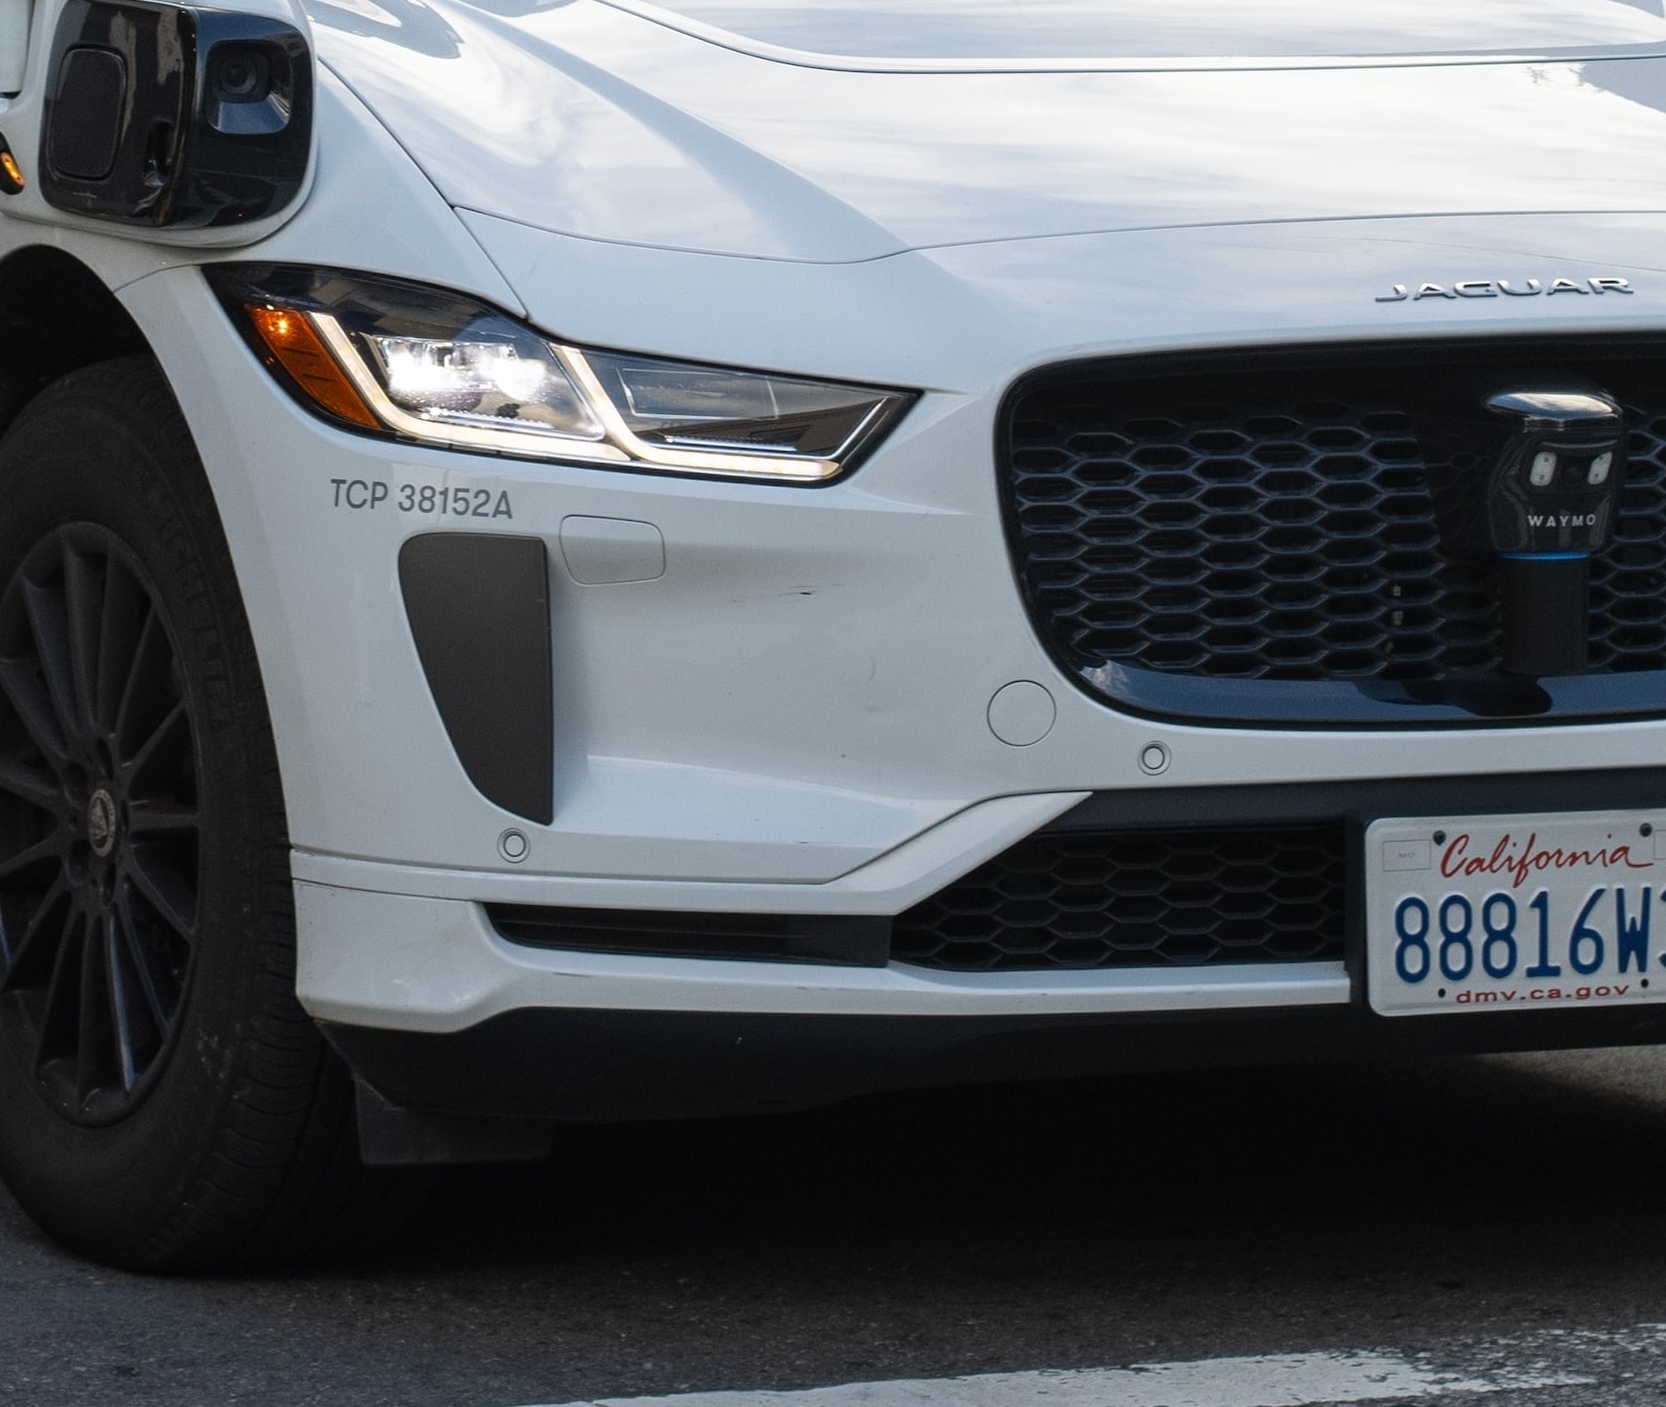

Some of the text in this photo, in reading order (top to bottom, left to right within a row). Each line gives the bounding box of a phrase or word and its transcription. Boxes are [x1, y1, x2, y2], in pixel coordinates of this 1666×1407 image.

[1375, 277, 1635, 304] JAGUAR
[331, 478, 513, 519] TCP 38152A
[1527, 513, 1596, 527] WAYMO
[1439, 832, 1654, 889] California
[1456, 984, 1630, 1005] dmv.ca.gov
